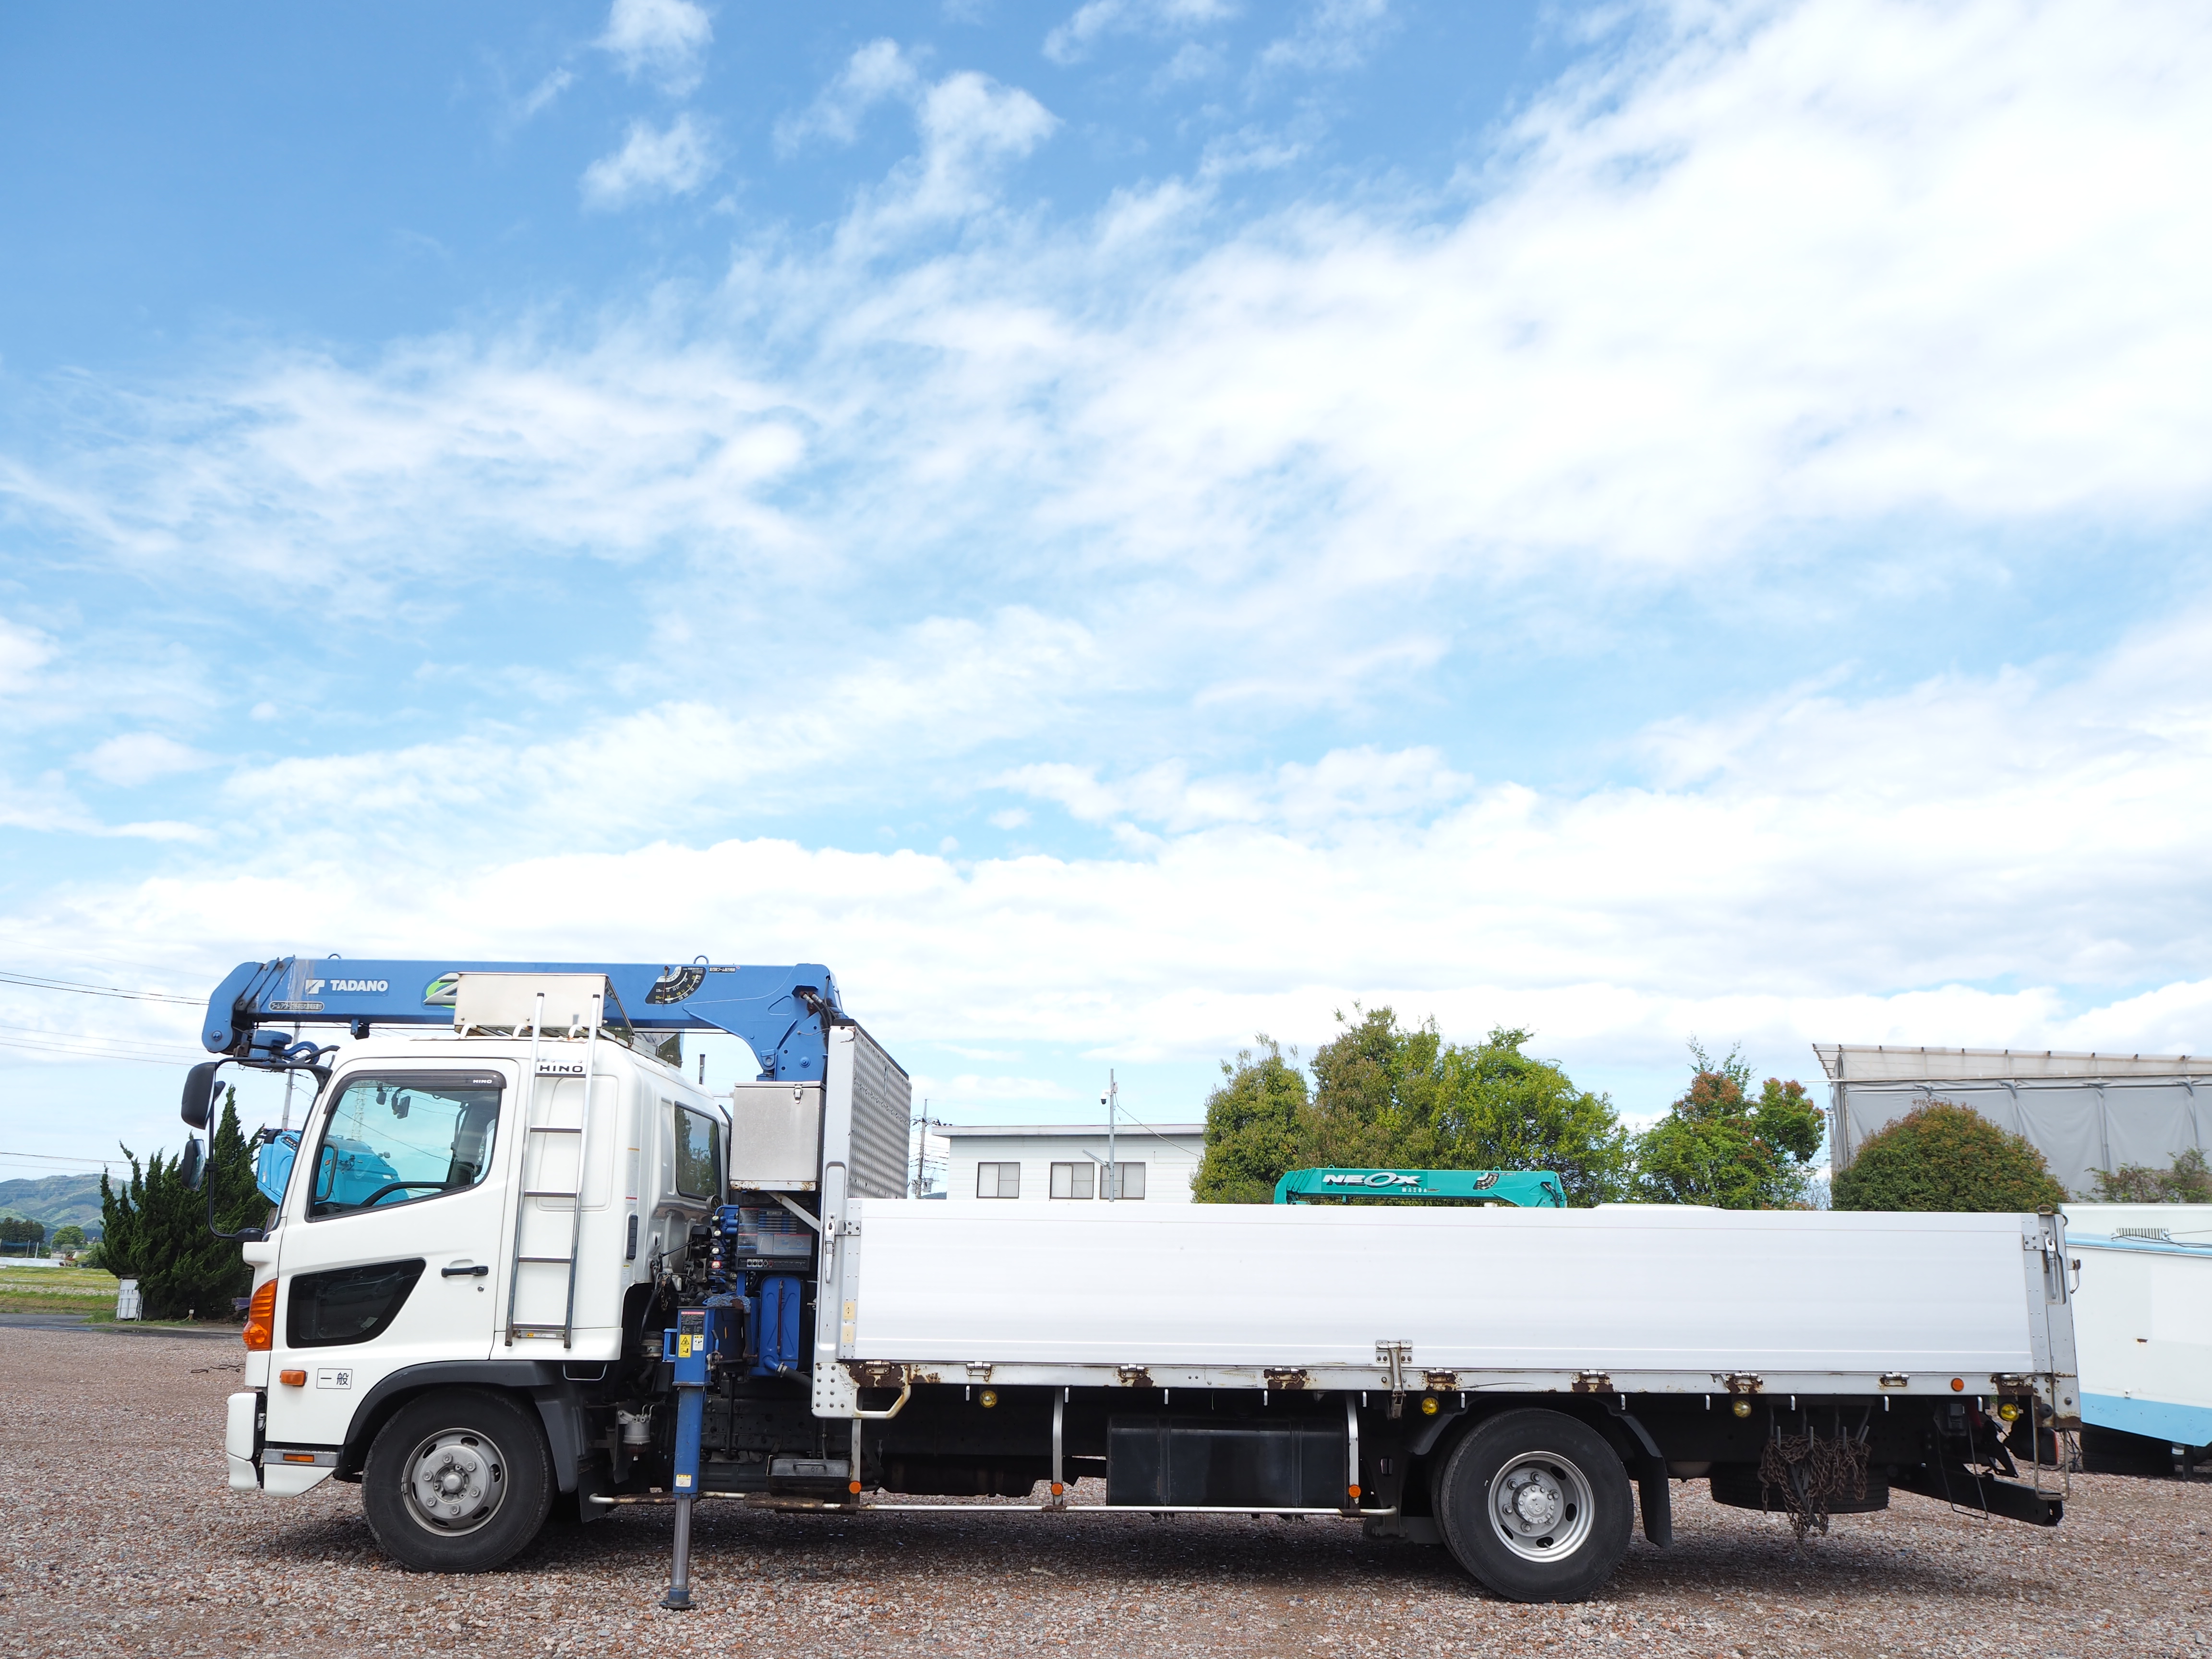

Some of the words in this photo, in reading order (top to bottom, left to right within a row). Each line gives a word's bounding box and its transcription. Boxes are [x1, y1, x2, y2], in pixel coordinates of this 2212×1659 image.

[330, 980, 388, 992] TADANO
[539, 1065, 583, 1073] HINO
[1322, 1172, 1422, 1188] NEOX
[320, 1372, 349, 1385] 一般
